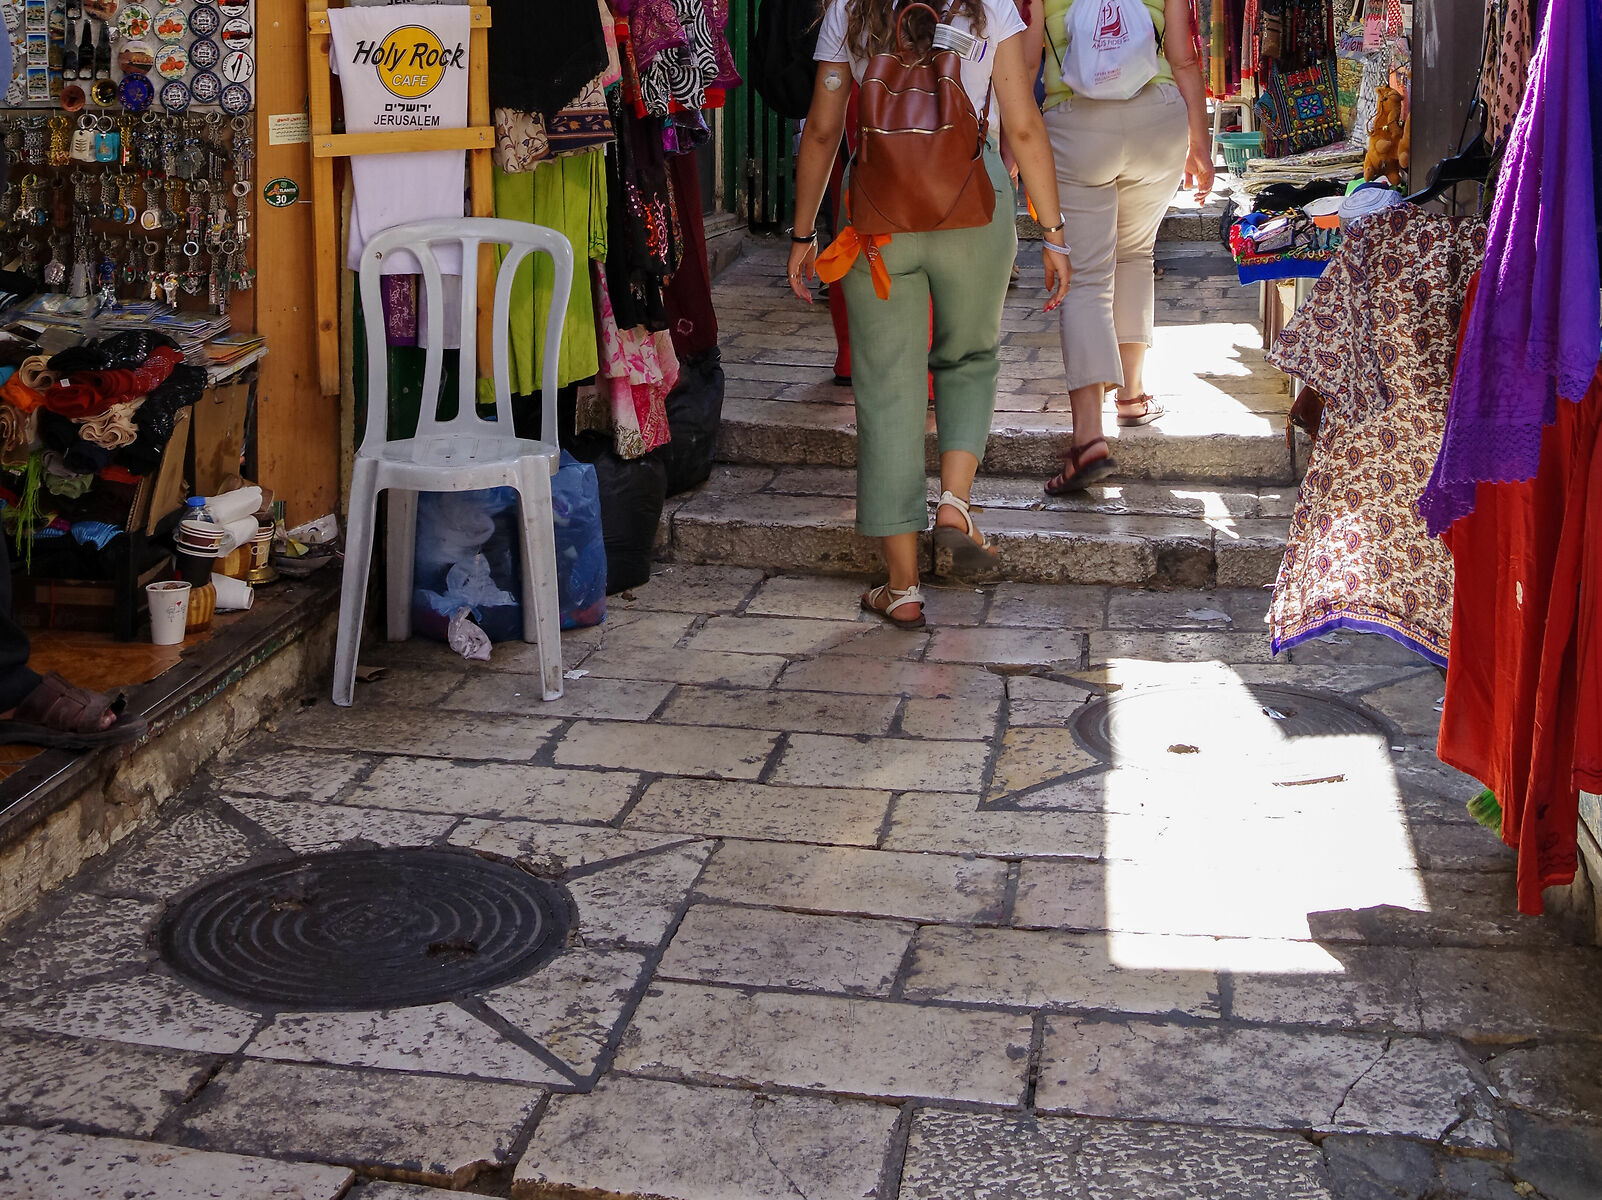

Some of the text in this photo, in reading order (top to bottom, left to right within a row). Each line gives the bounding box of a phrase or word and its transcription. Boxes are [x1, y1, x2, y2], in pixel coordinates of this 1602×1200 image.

[352, 40, 466, 72] Holy Rock
[392, 74, 430, 87] CAFE
[384, 103, 432, 112] ירושלים
[373, 114, 440, 127] JERUSALEM
[276, 195, 287, 204] 30
